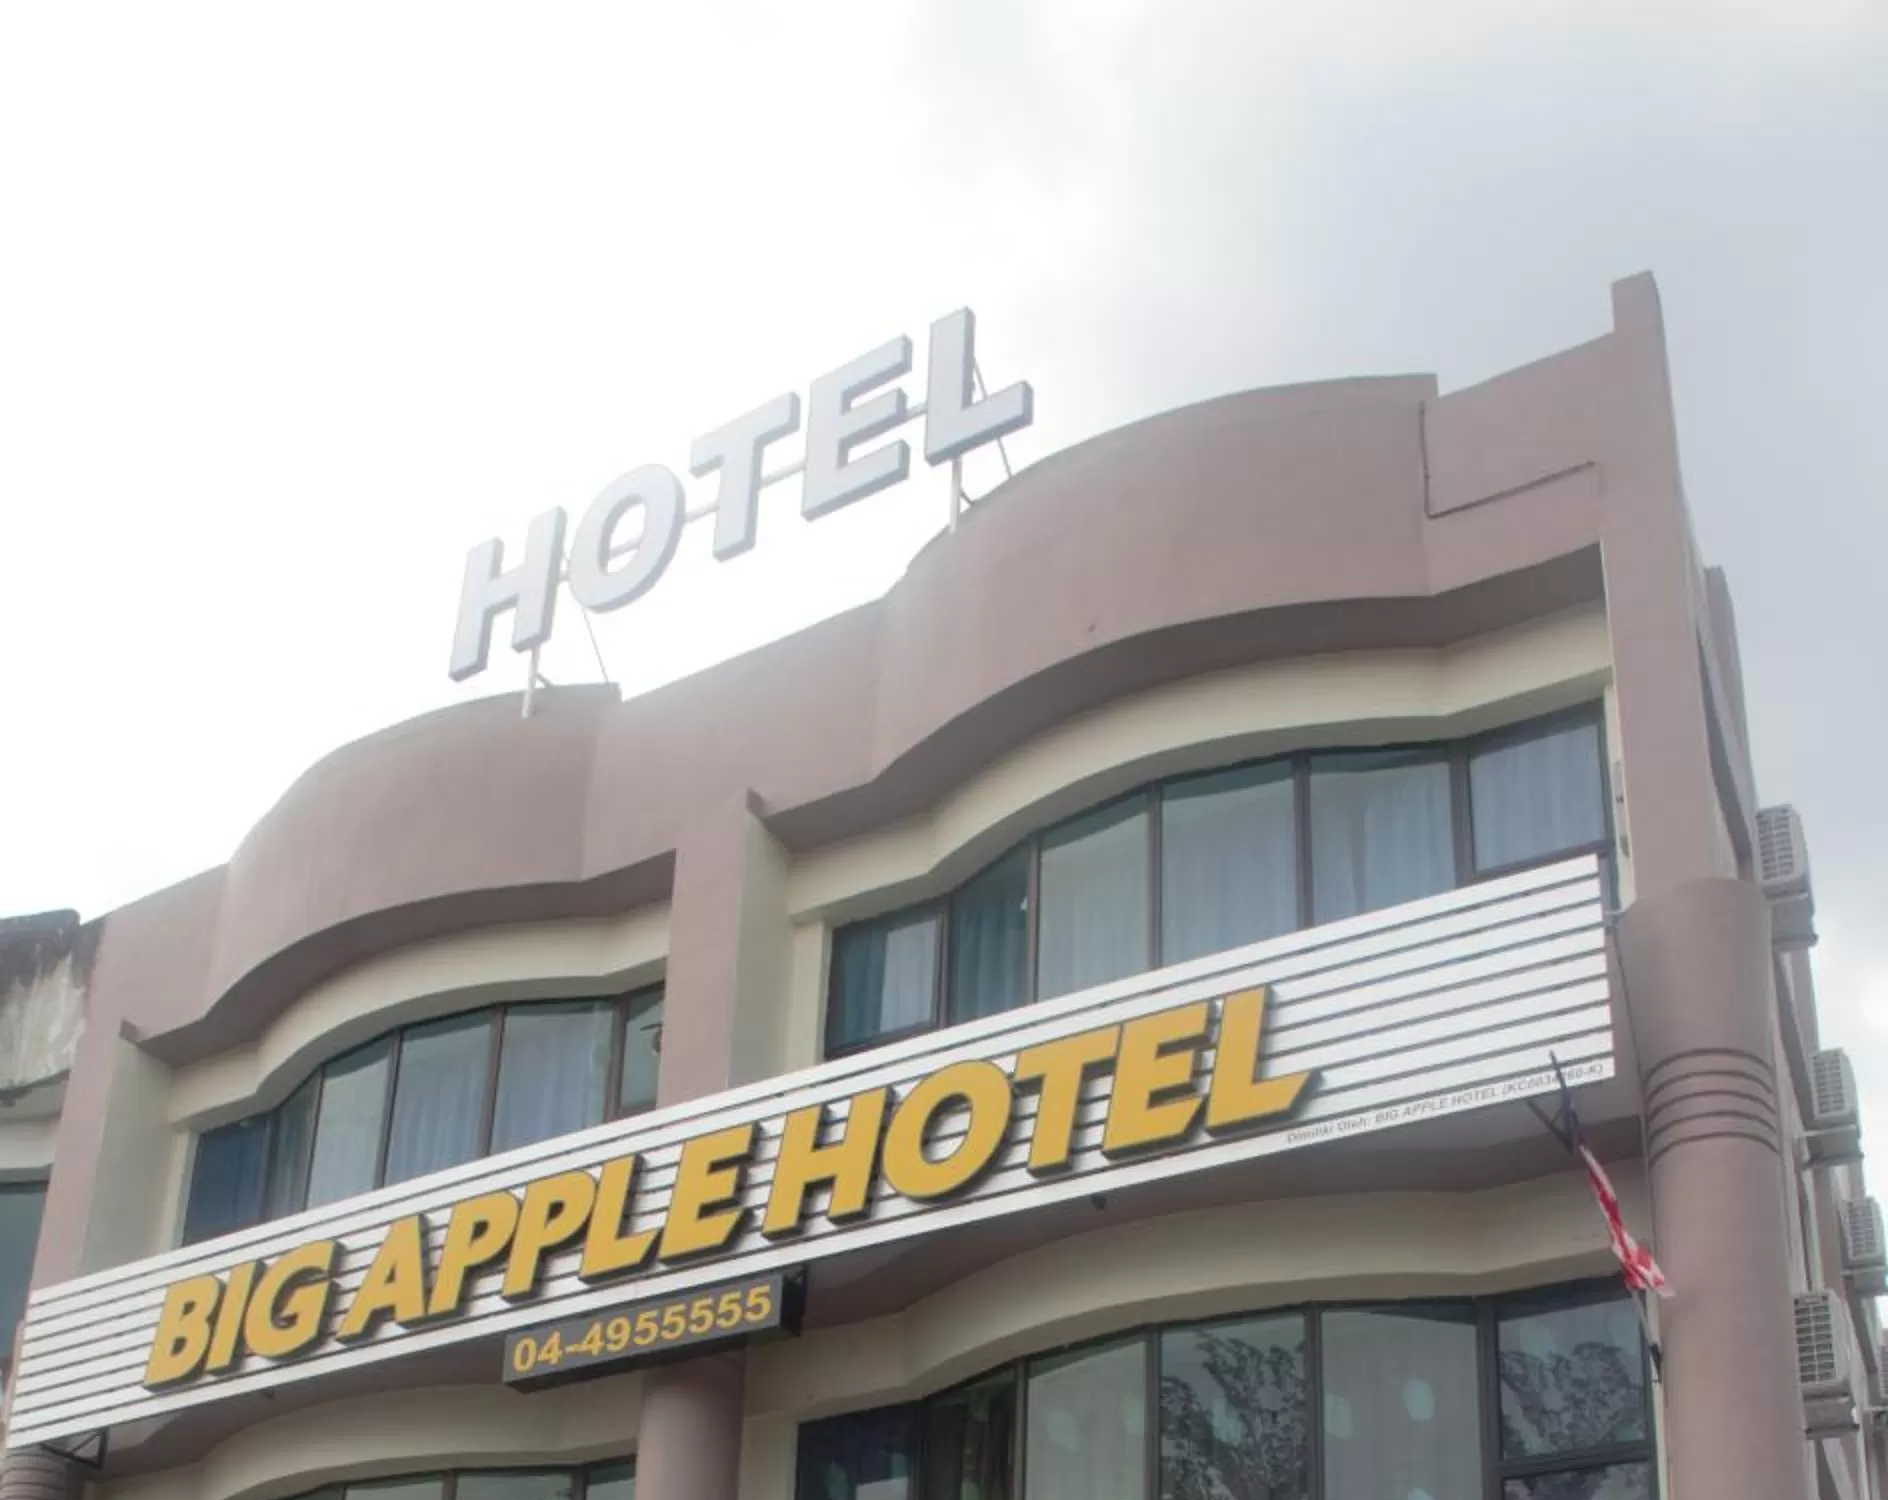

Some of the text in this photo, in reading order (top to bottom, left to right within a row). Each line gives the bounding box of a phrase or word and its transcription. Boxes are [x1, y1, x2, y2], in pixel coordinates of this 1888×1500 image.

[448, 306, 1034, 683] HOTEL
[143, 984, 1322, 1392] BIG APPLE HOTEL
[513, 1285, 772, 1373] 04-4955555
